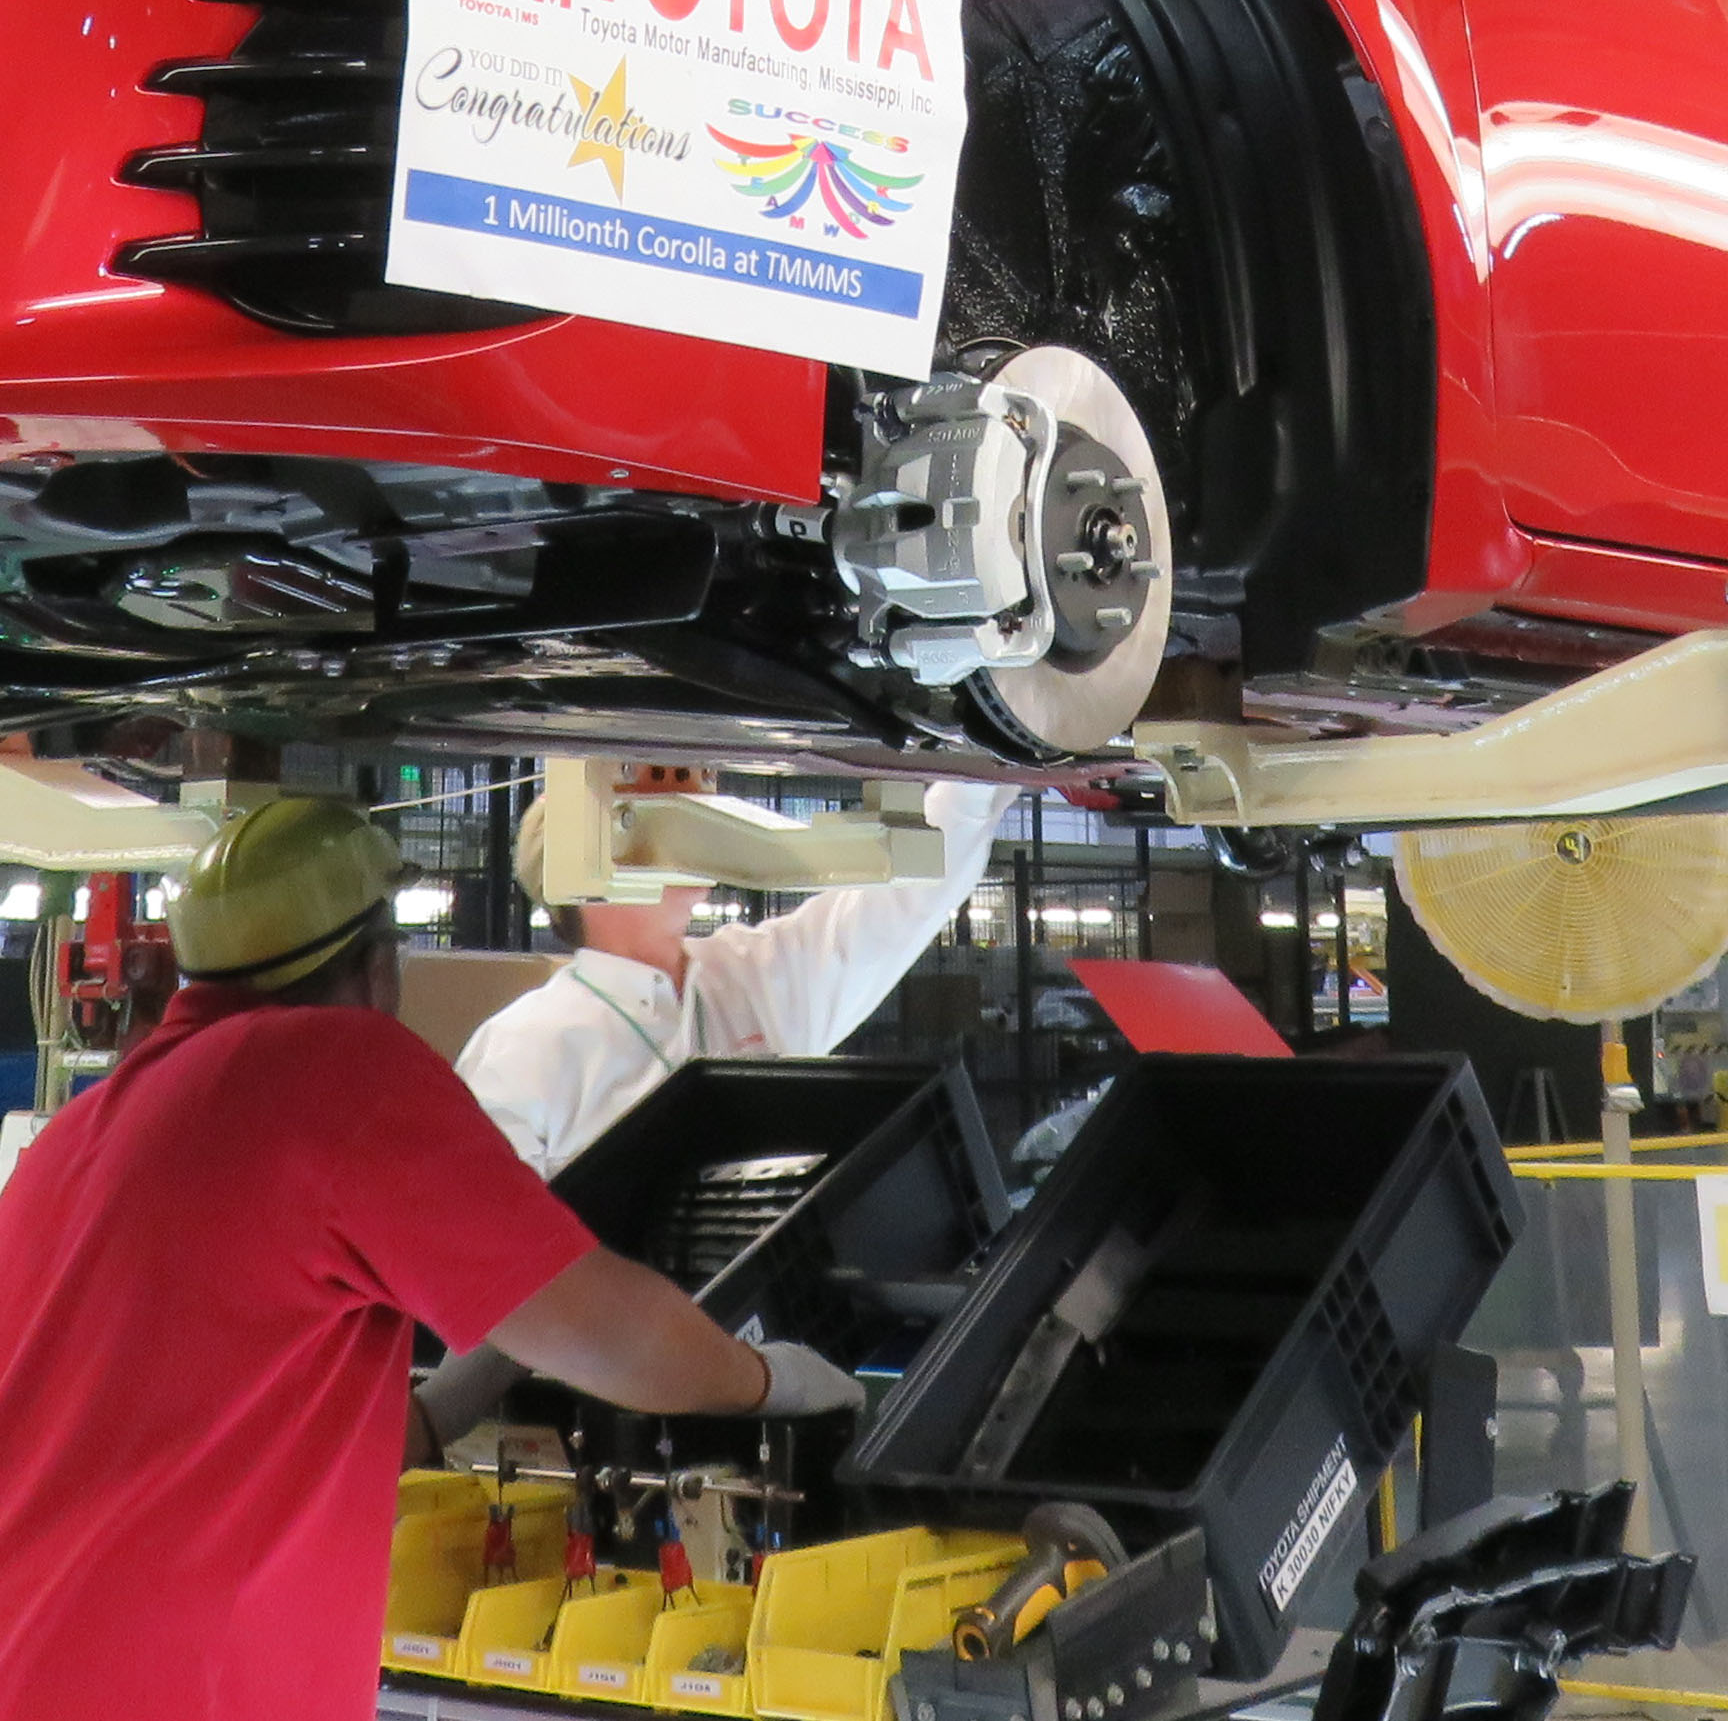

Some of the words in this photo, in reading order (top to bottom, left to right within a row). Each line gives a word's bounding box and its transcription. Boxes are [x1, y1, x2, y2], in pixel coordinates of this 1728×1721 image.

[415, 47, 691, 162] Congratulations
[468, 49, 505, 73] YOU
[510, 59, 540, 81] DID
[580, 7, 637, 45] Toyota
[644, 22, 690, 56] Motor
[697, 36, 812, 91] Manufacturing,
[819, 65, 904, 111] Mississippi,
[911, 91, 936, 117] Inc.
[727, 98, 910, 153] SUCCESS
[482, 196, 499, 226] 1
[509, 199, 629, 252] Millionth
[637, 225, 726, 270] Corolla
[733, 250, 759, 277] at
[765, 251, 863, 298] TMMMS
[1258, 1519, 1300, 1591] TOYOTA
[1297, 1432, 1347, 1523] SHIPMENT
[1276, 1578, 1289, 1601] K
[1319, 1467, 1352, 1529] NIFKY
